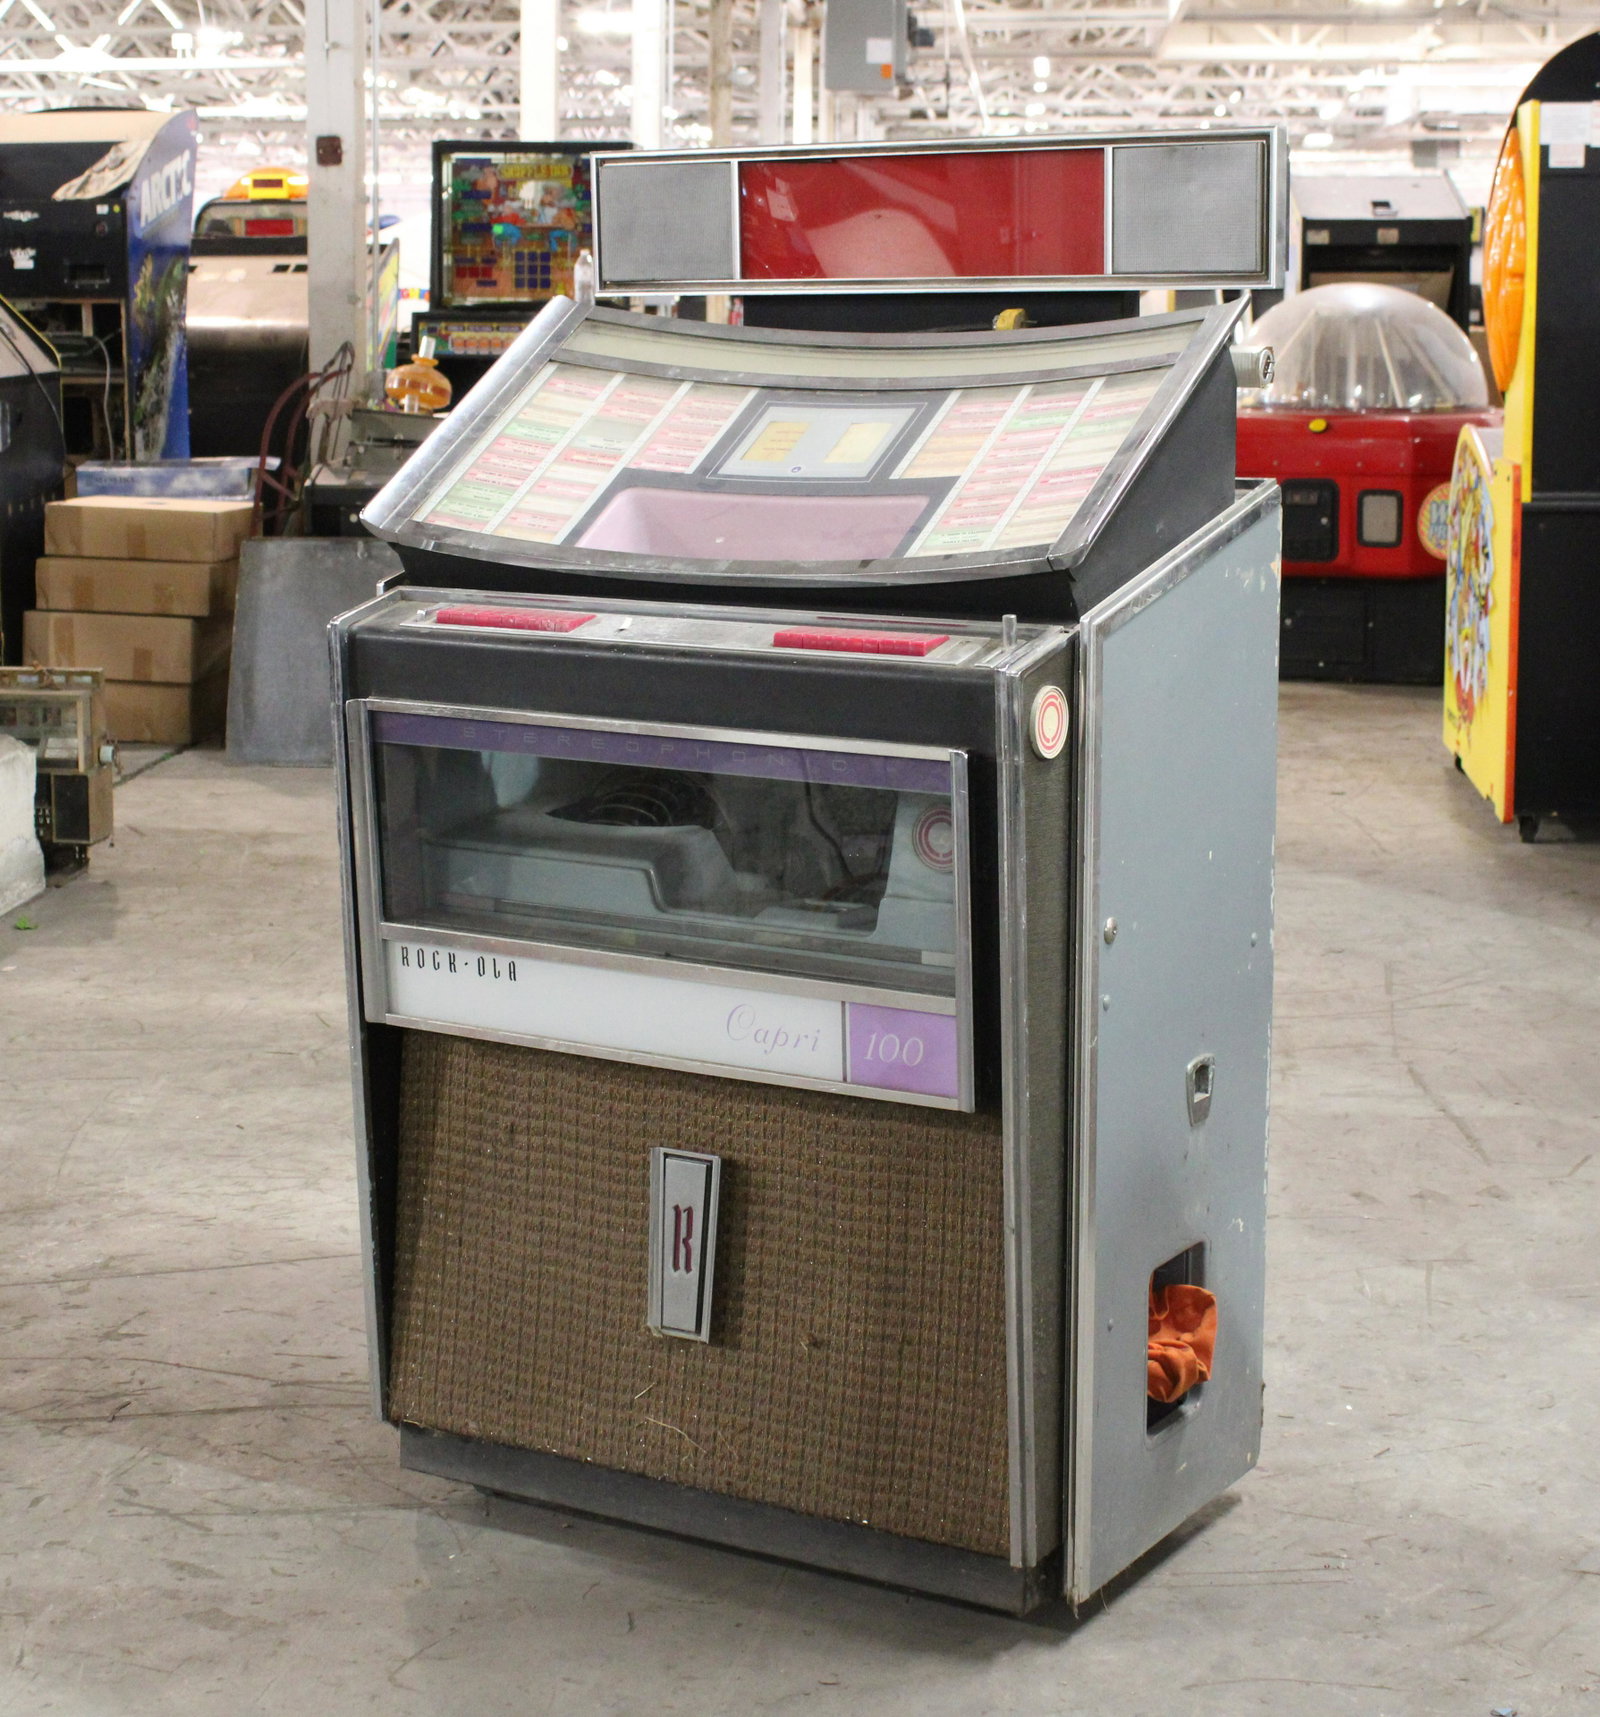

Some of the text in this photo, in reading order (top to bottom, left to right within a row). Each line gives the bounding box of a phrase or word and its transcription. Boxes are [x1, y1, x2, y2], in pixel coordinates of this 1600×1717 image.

[462, 726, 849, 771] STEREOPHONIC
[725, 1003, 822, 1055] Capri
[863, 1031, 925, 1068] 100
